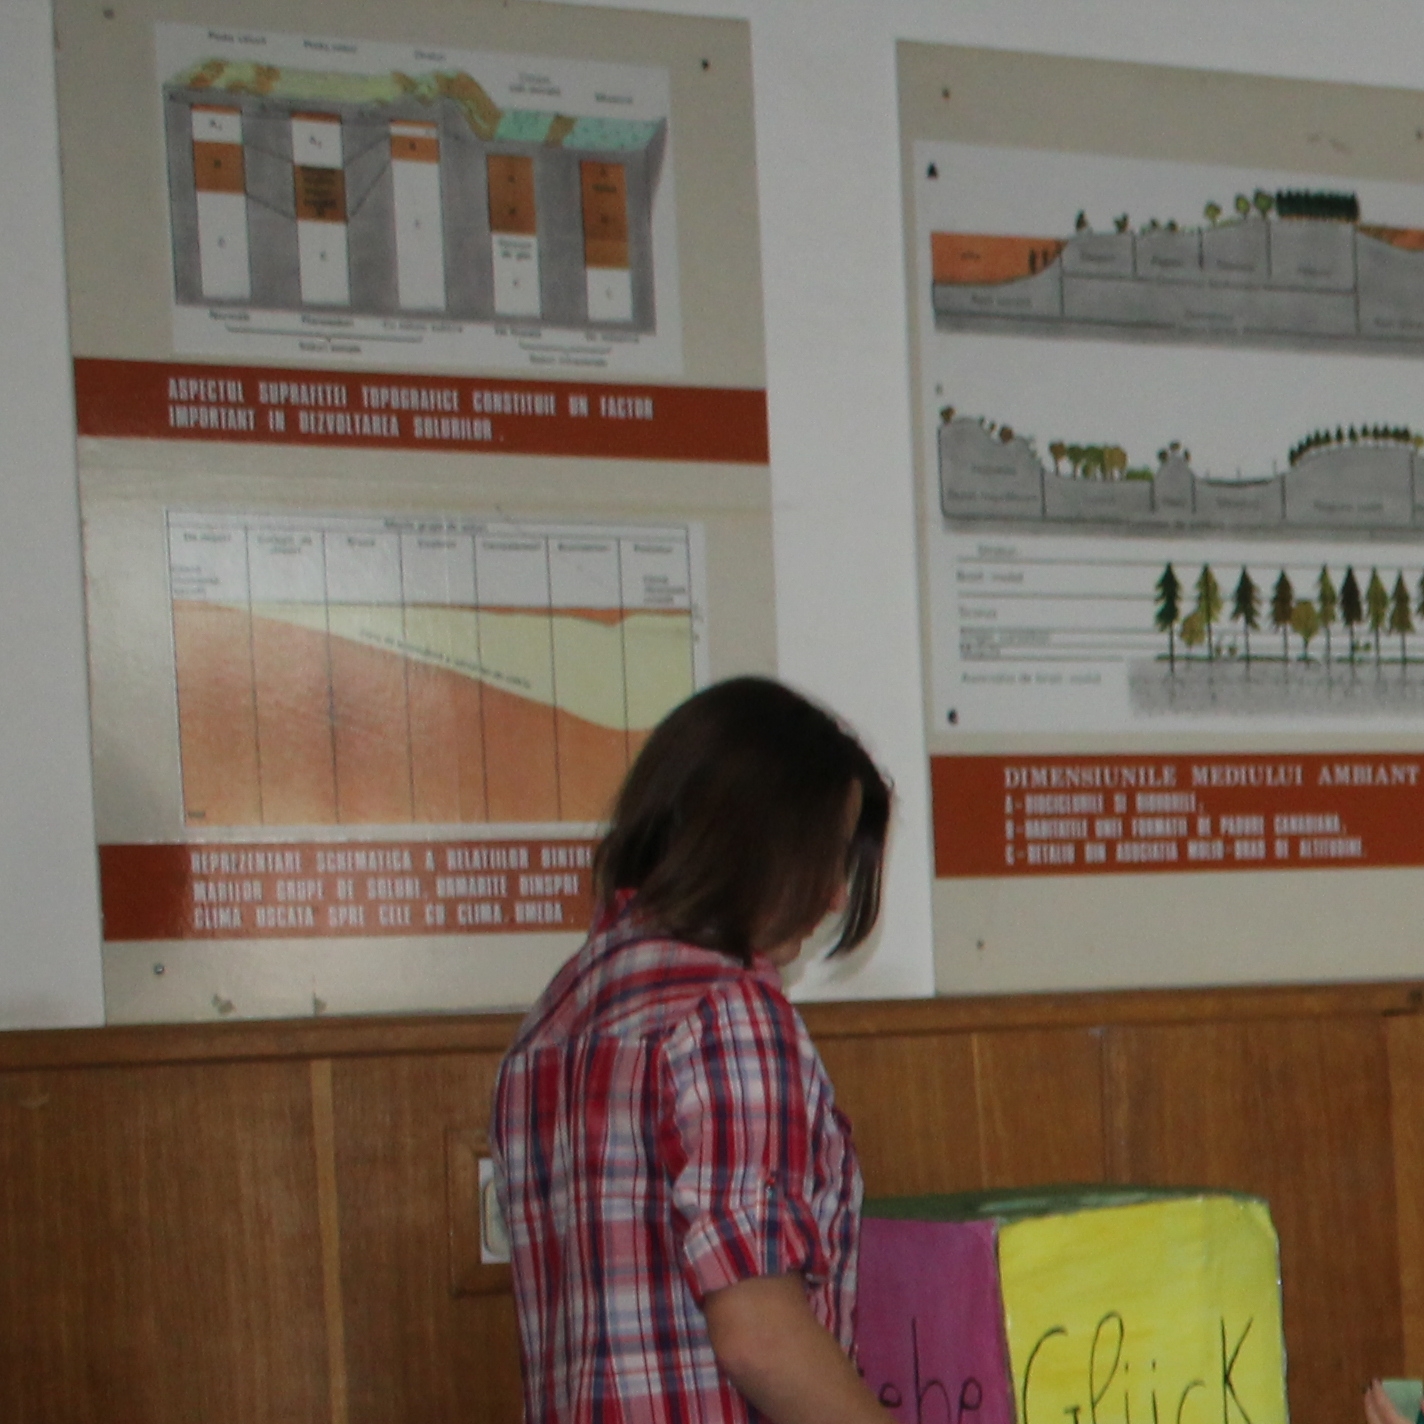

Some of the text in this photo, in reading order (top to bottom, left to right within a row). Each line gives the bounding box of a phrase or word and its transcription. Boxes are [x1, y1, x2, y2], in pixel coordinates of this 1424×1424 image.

[168, 377, 244, 404] ASPECTUL
[361, 385, 459, 412] TOPOGRAFICE
[568, 393, 588, 418] UN
[600, 396, 653, 420] FACTOR
[169, 405, 255, 431] IMPORTANT
[298, 410, 400, 437] DEZVOLTAREA
[1004, 763, 1420, 789] DIMENSIUNILE MEDIULUI AMBIANT
[316, 848, 413, 874] SCHEMATICA
[424, 849, 435, 872] A
[193, 905, 242, 930] CLIMA
[328, 905, 365, 929] SPRE
